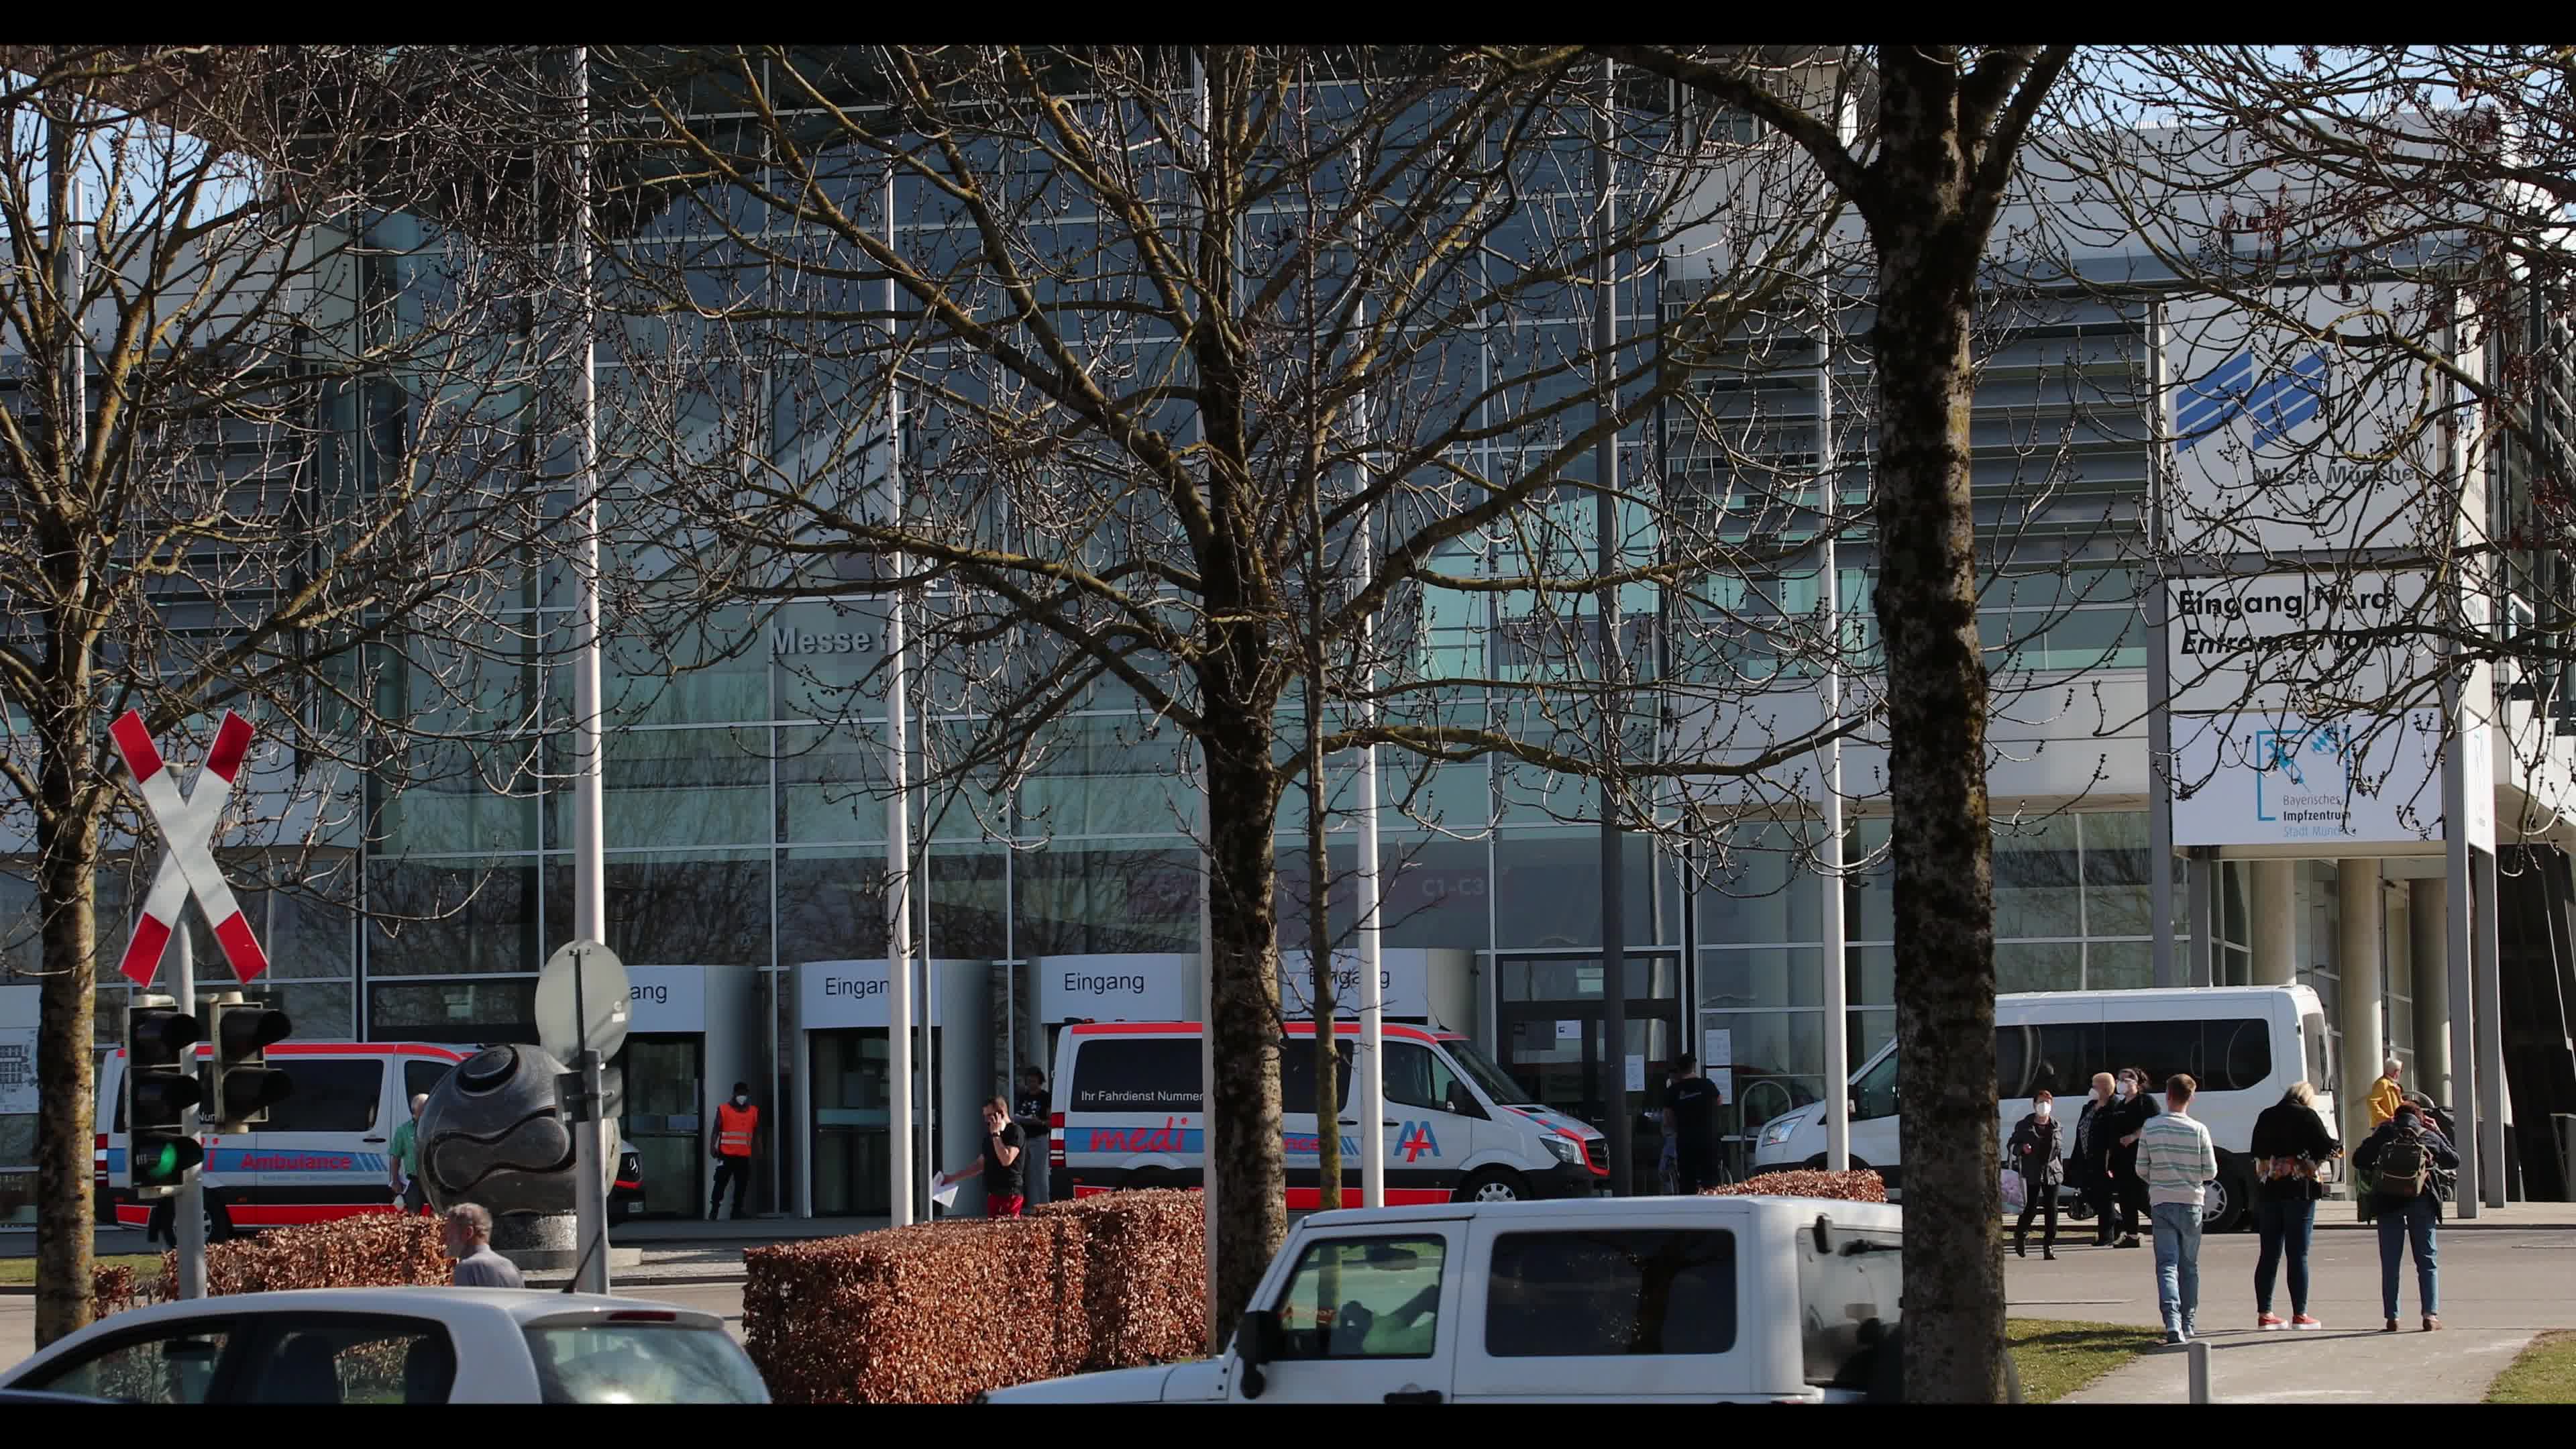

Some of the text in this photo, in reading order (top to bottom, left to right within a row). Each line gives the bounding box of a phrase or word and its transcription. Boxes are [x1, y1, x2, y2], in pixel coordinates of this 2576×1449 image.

[2179, 590, 2302, 620] Eingang
[773, 627, 871, 655] Messe
[2283, 794, 2341, 808] Bayerisches
[825, 977, 890, 1000] Eingan
[1064, 973, 1144, 995] Eingang
[1081, 1090, 1204, 1102] Ihr Fahrdienst Nummer
[1089, 1116, 1188, 1152] medi
[240, 1153, 352, 1170] Ambulance
